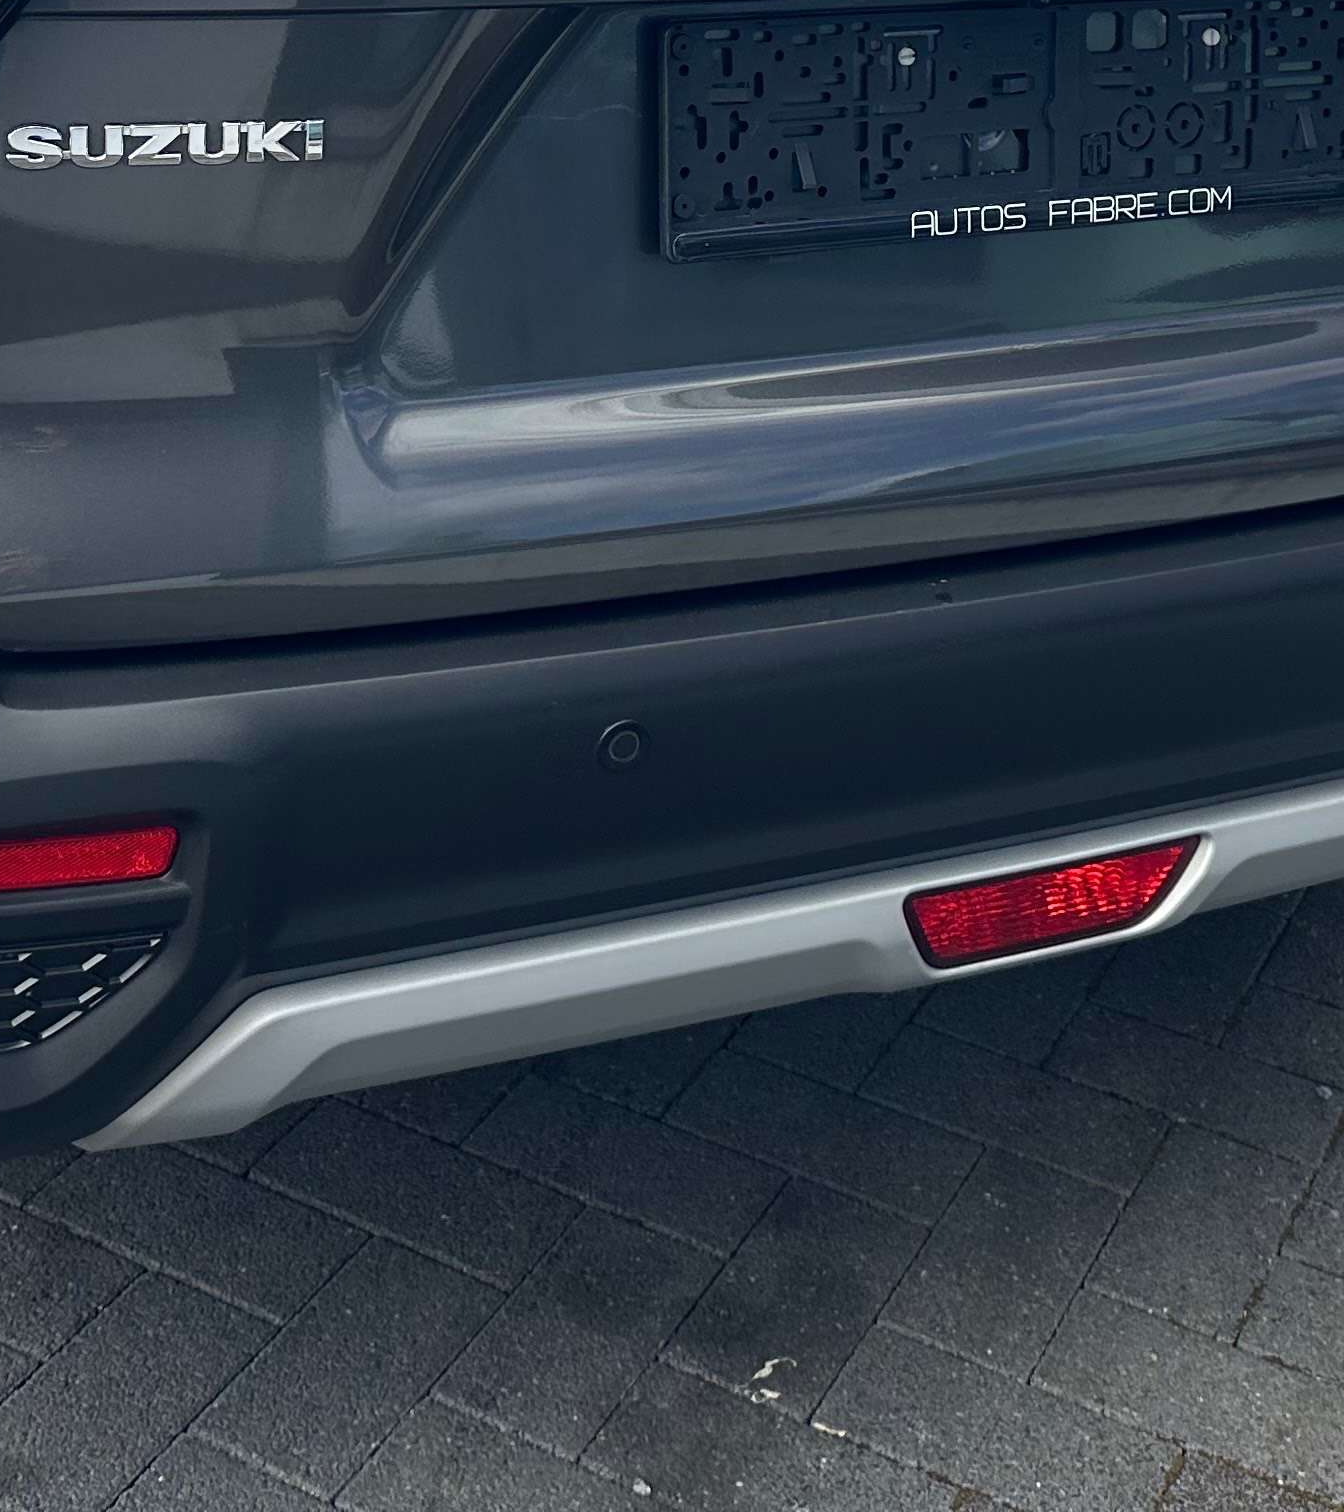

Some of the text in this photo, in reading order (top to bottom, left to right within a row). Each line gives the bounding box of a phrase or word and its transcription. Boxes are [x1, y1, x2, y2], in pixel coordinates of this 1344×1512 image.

[5, 119, 325, 171] SUZUKI
[911, 185, 1232, 239] AUTOS FABRE.COM
